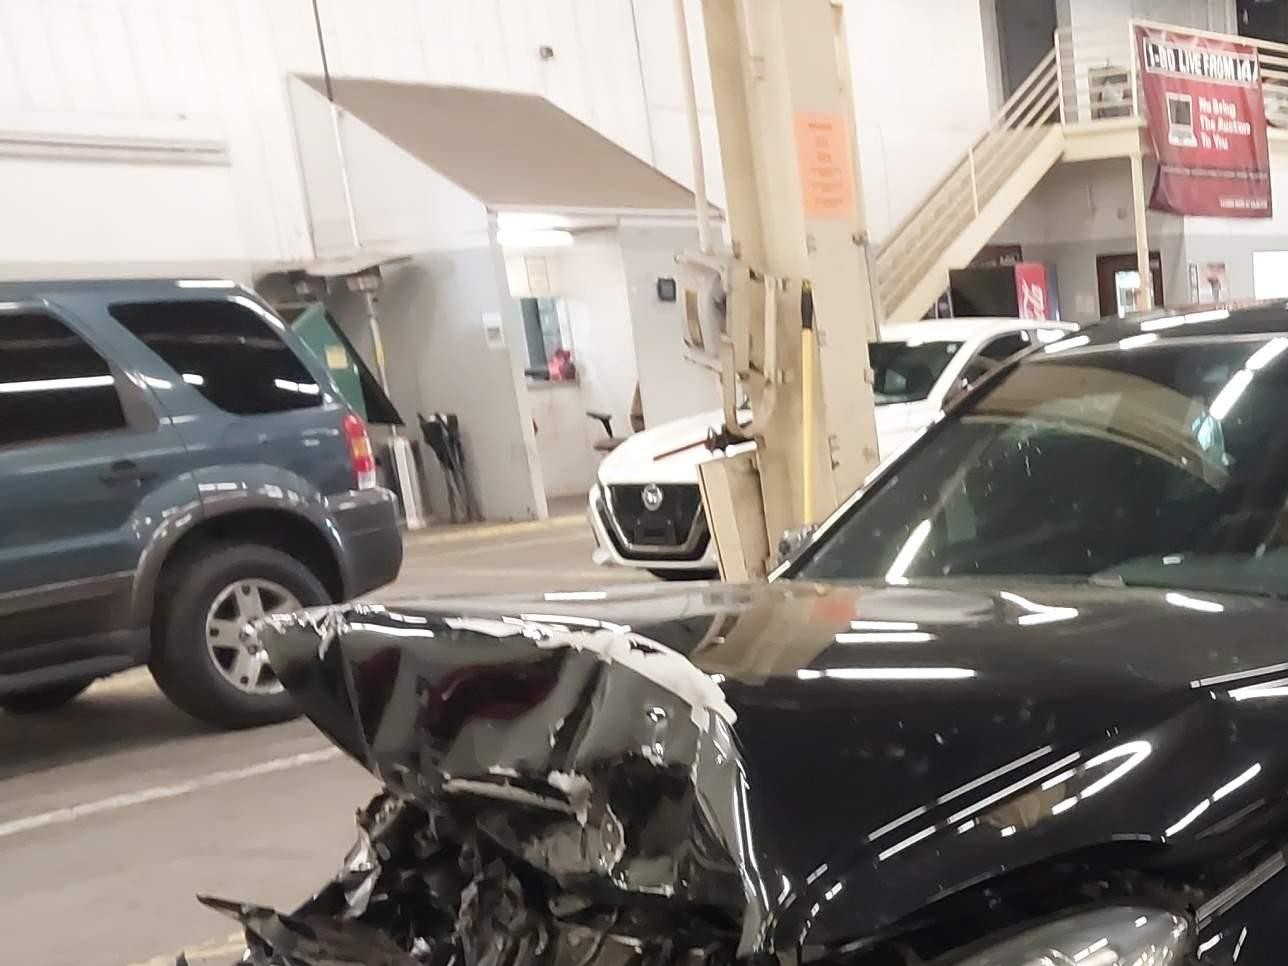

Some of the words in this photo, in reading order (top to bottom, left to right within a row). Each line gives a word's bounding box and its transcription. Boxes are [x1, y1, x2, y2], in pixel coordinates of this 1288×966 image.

[1178, 48, 1203, 77] LIVE
[1203, 52, 1236, 81] FROM
[1200, 114, 1216, 131] The
[1213, 132, 1229, 150] You
